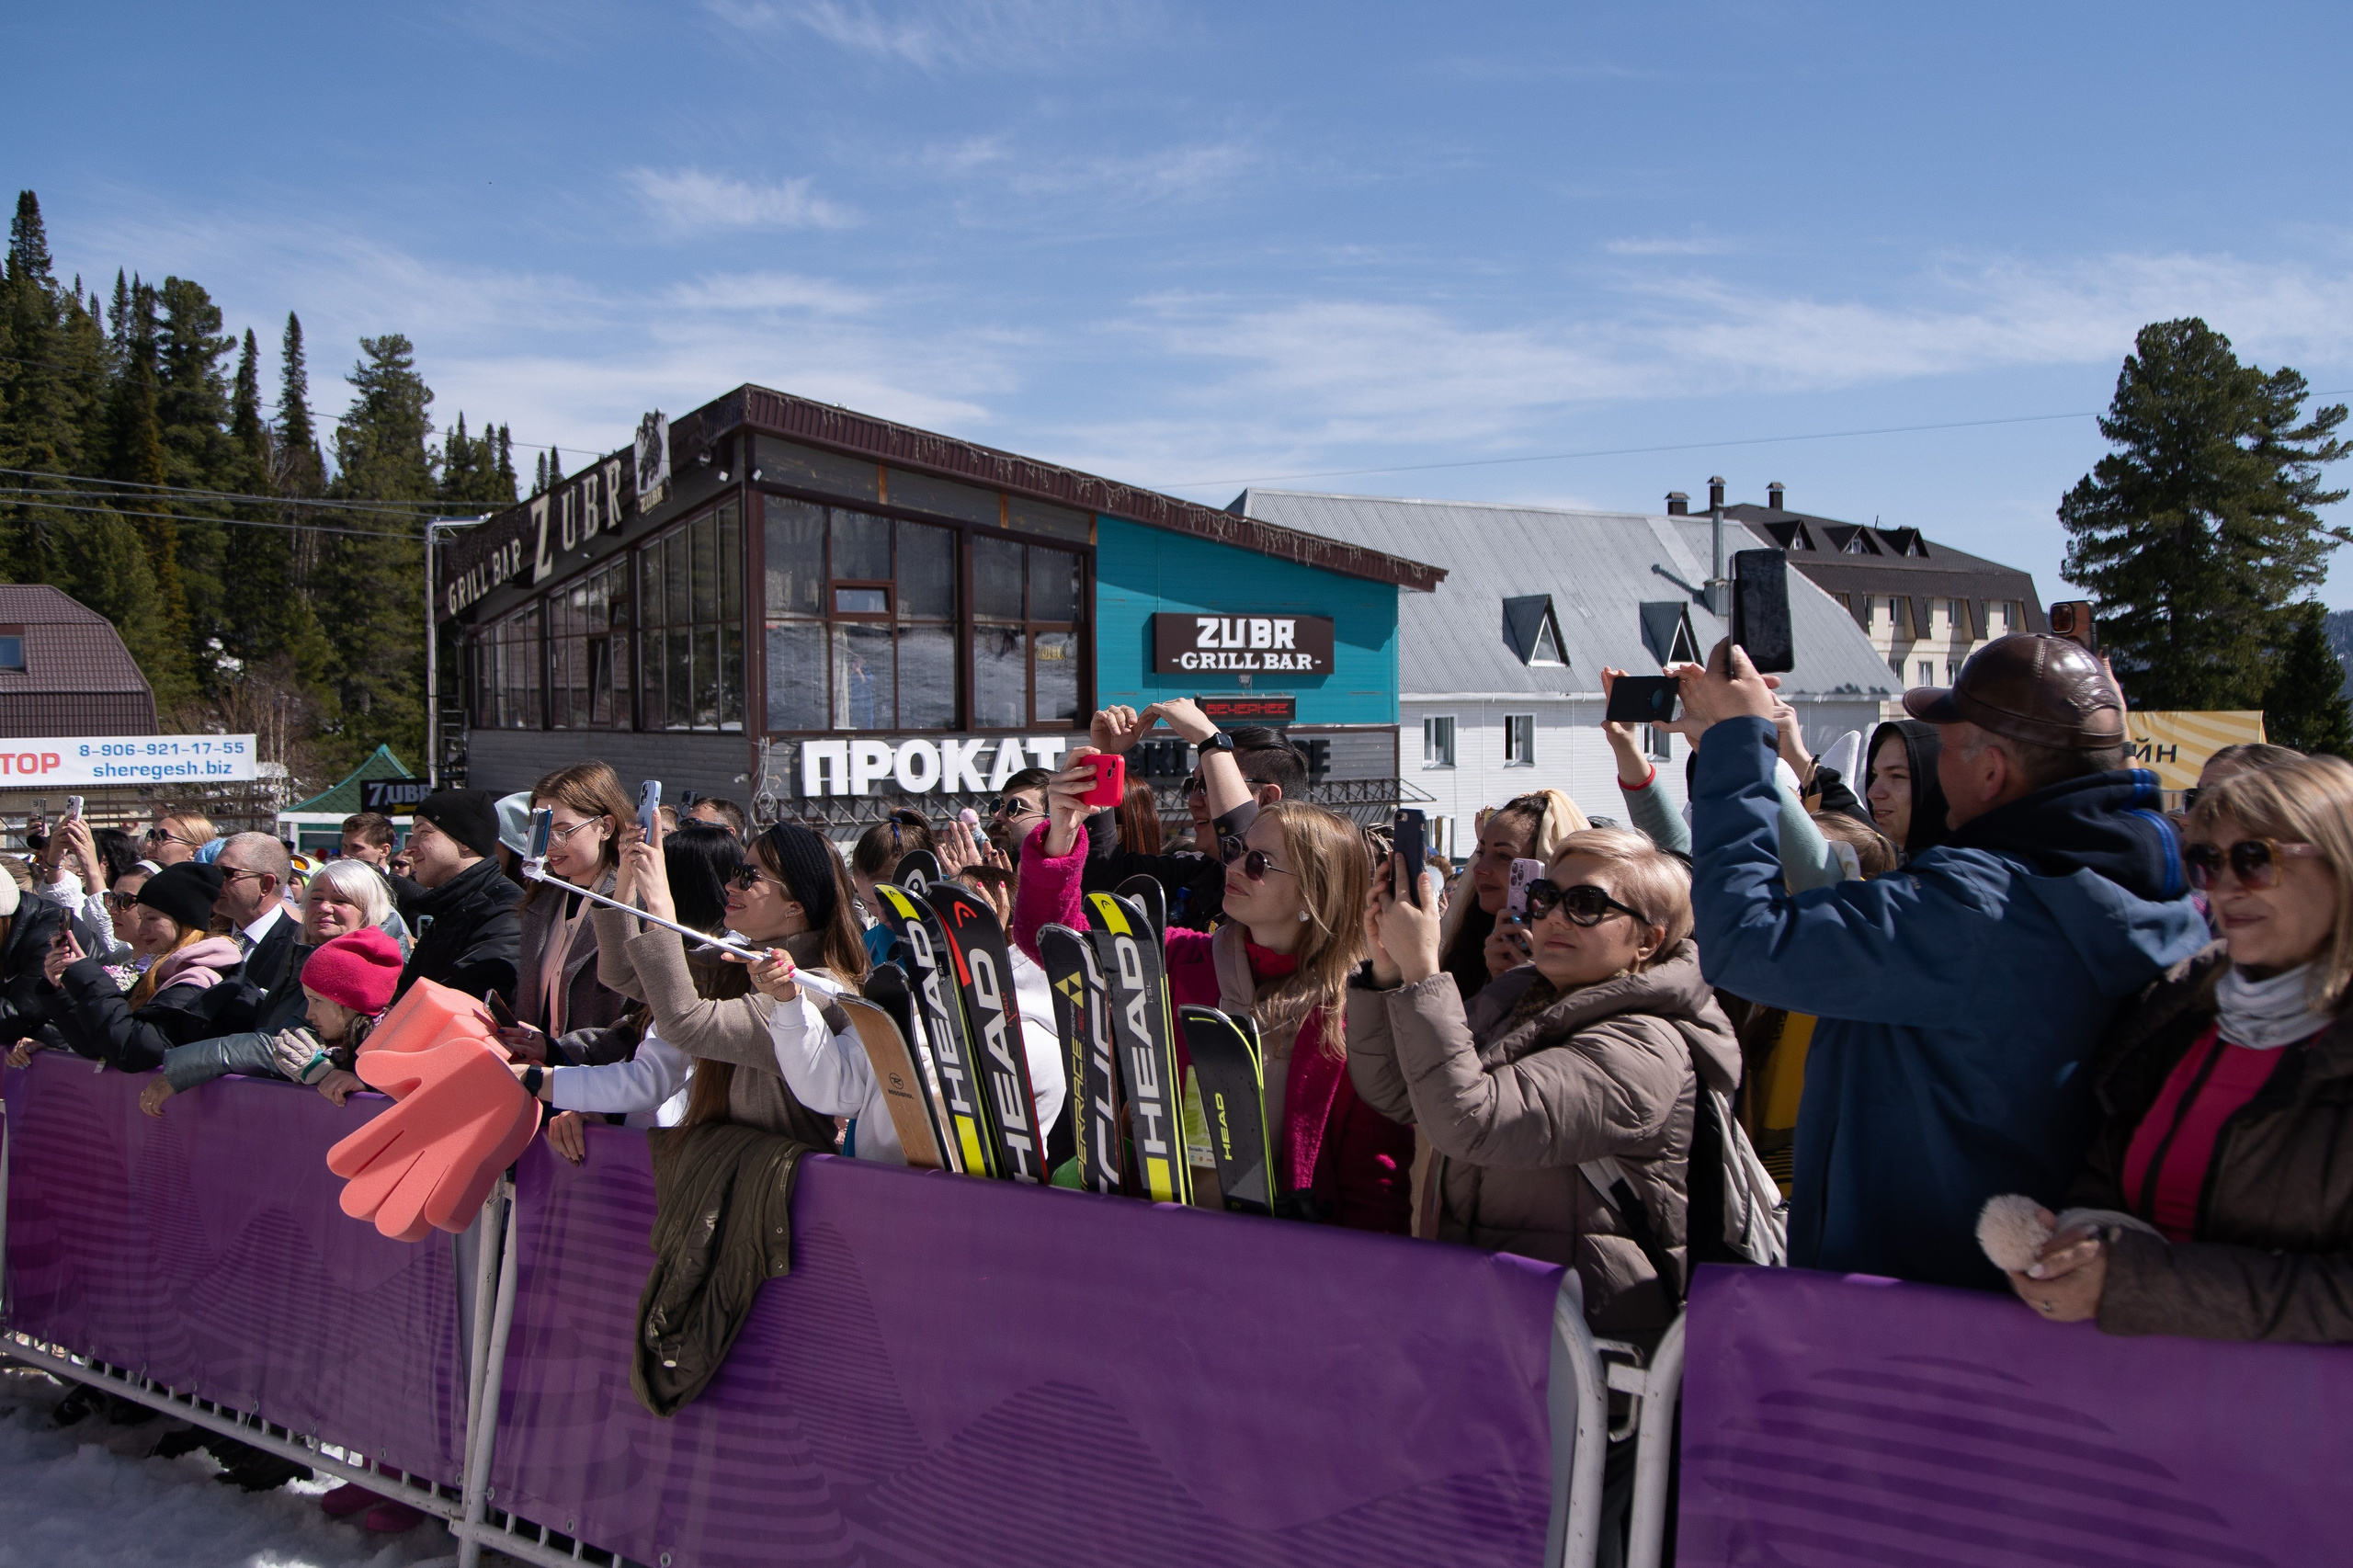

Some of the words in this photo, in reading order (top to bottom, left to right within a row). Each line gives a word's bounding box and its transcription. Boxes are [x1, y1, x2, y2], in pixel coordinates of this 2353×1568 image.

[448, 562, 488, 615] GRILL
[492, 539, 521, 587] BAR
[530, 460, 622, 585] ZUBR
[1197, 618, 1296, 650] ZUBR
[79, 742, 245, 756] 8-906-921-17-55
[93, 760, 233, 779] sheregesh.biz
[801, 737, 1066, 797] ПРОКАТ
[906, 920, 971, 1114] HEAD
[1114, 936, 1168, 1153] HEAD
[969, 948, 1040, 1185] HEAD
[1214, 1093, 1233, 1160] HEAD
